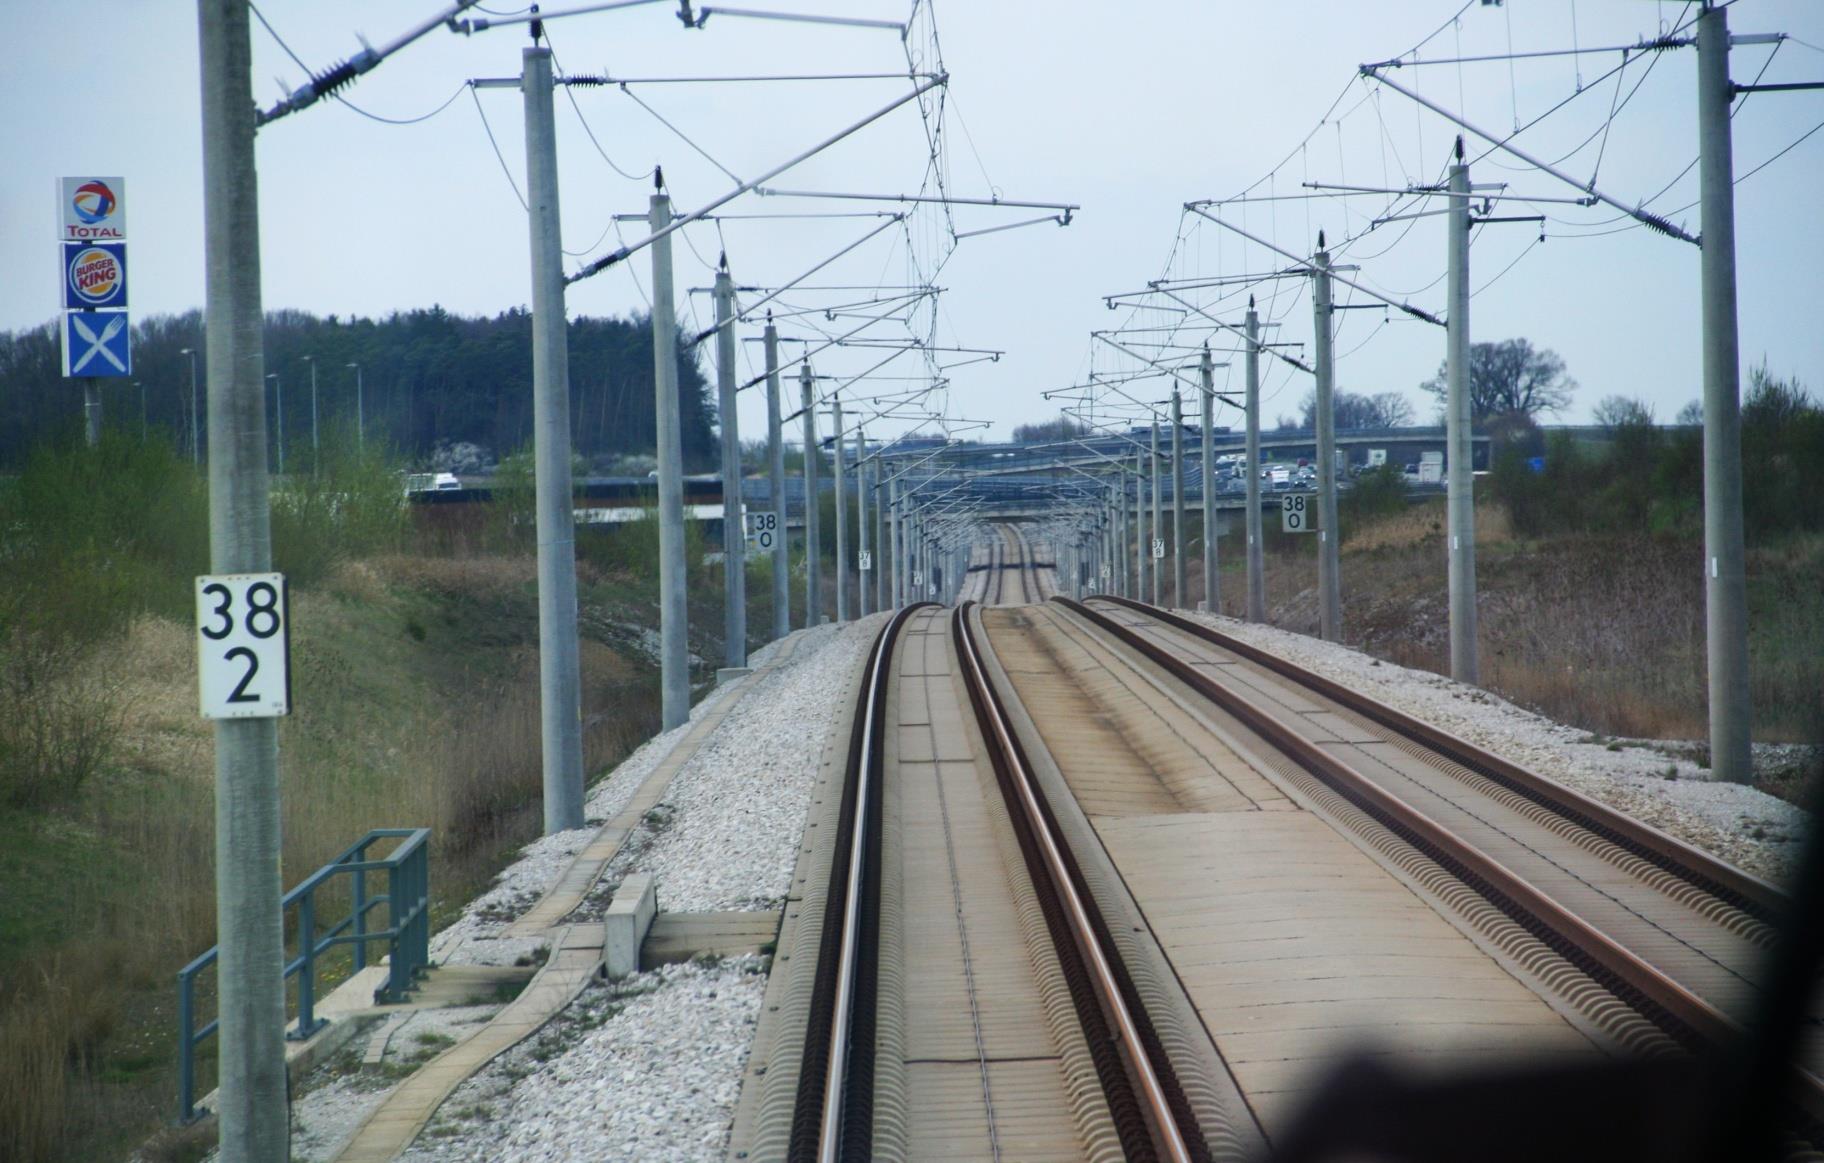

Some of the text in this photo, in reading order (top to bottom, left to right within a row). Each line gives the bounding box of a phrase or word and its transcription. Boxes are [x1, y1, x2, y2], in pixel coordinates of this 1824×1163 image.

[67, 225, 122, 237] TOTAL
[76, 259, 114, 277] BURGER
[78, 267, 116, 290] KING
[1284, 496, 1305, 511] 38
[756, 514, 776, 530] 38
[1288, 513, 1300, 528] 0
[760, 532, 772, 547] 0
[201, 581, 280, 640] 38
[223, 646, 261, 703] 2
